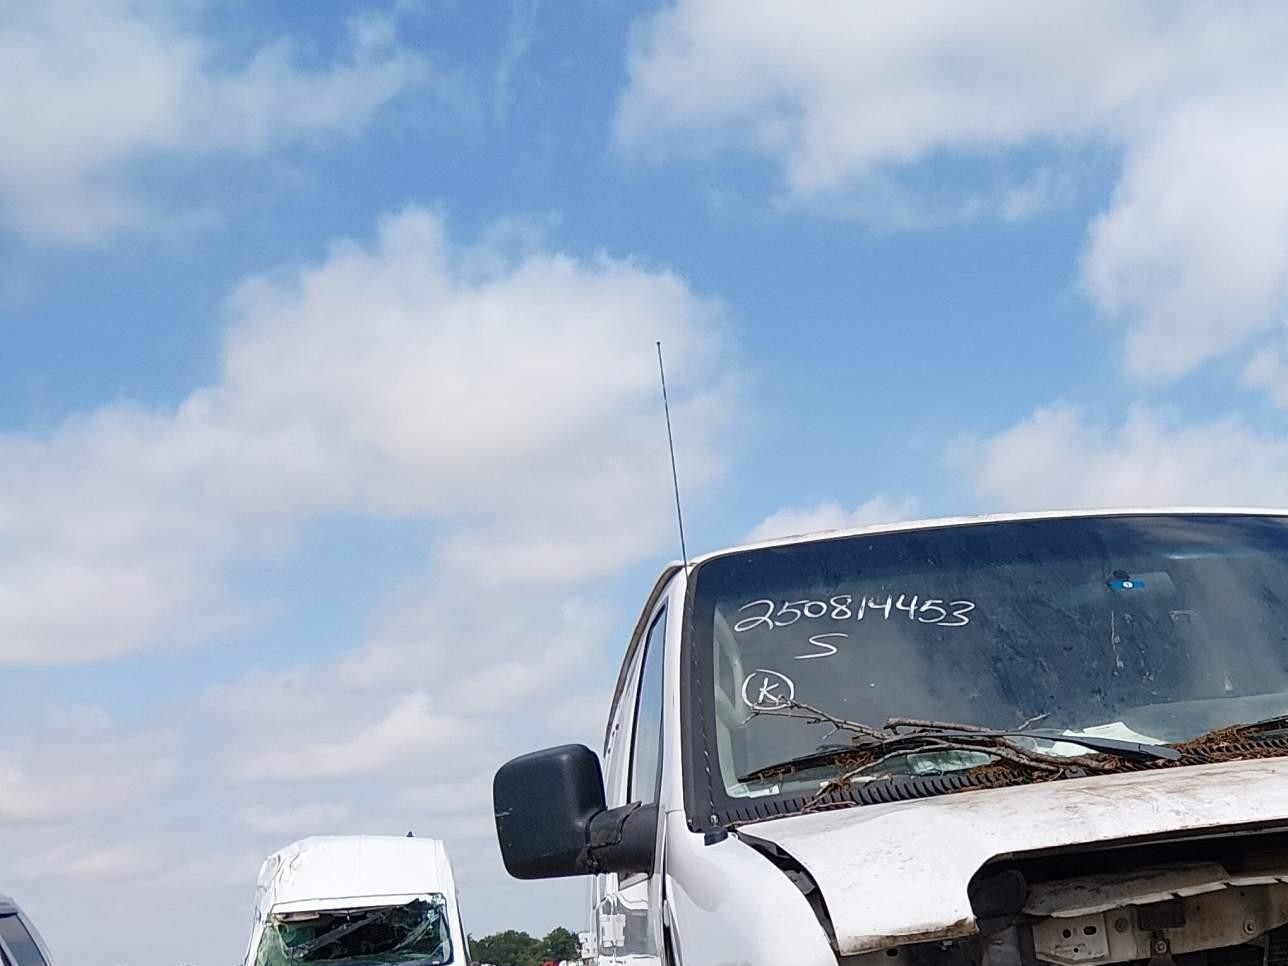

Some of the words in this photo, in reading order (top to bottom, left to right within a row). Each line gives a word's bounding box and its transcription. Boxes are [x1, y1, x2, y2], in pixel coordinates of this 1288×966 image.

[734, 594, 976, 632] 250814453
[793, 632, 849, 659] S
[757, 677, 780, 704] K
